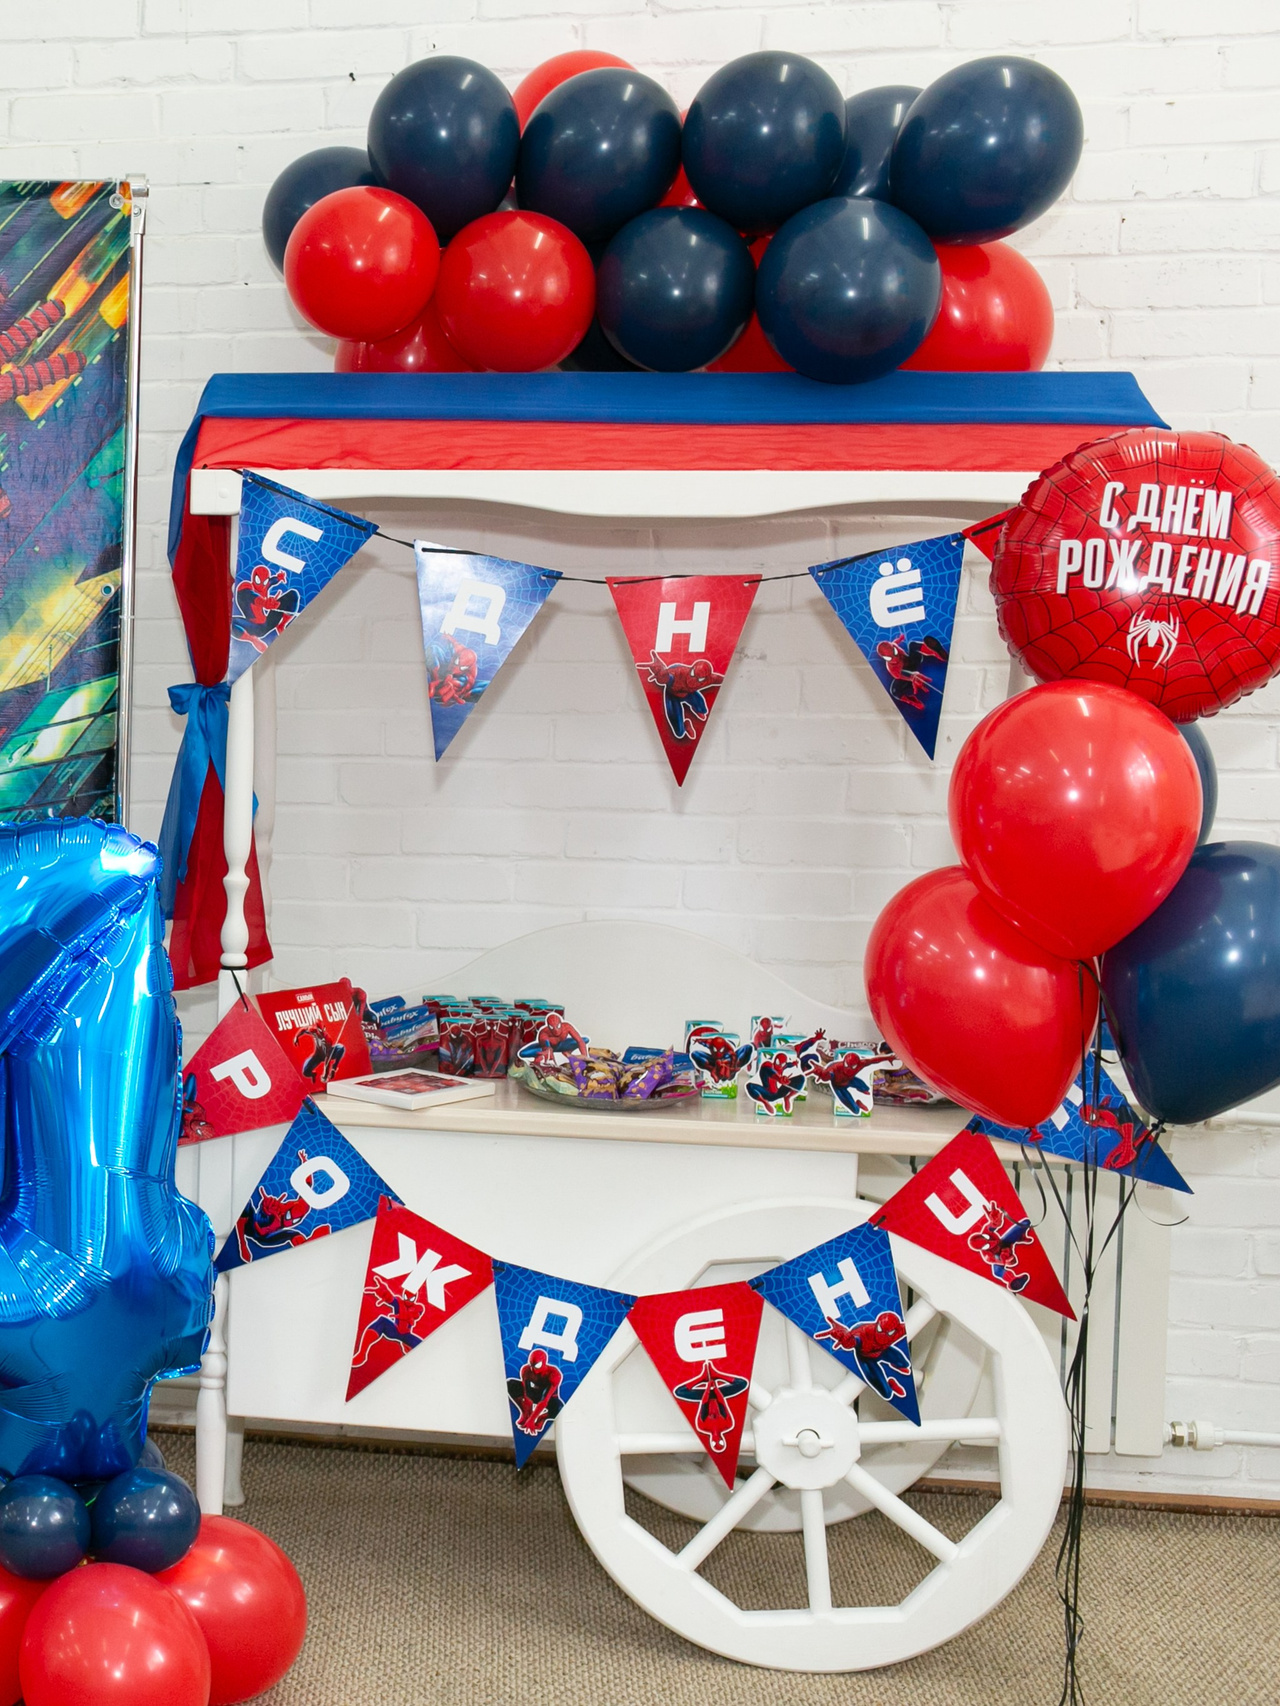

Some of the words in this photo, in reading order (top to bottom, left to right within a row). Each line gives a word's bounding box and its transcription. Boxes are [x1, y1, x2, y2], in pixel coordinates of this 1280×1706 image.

[1099, 481, 1125, 529] С
[1127, 478, 1232, 540] ДНЁМ
[1056, 538, 1271, 616] РОЖДЕНИЯ
[275, 1002, 323, 1031] ЛУЧШИЙ
[323, 1001, 348, 1023] СЫН
